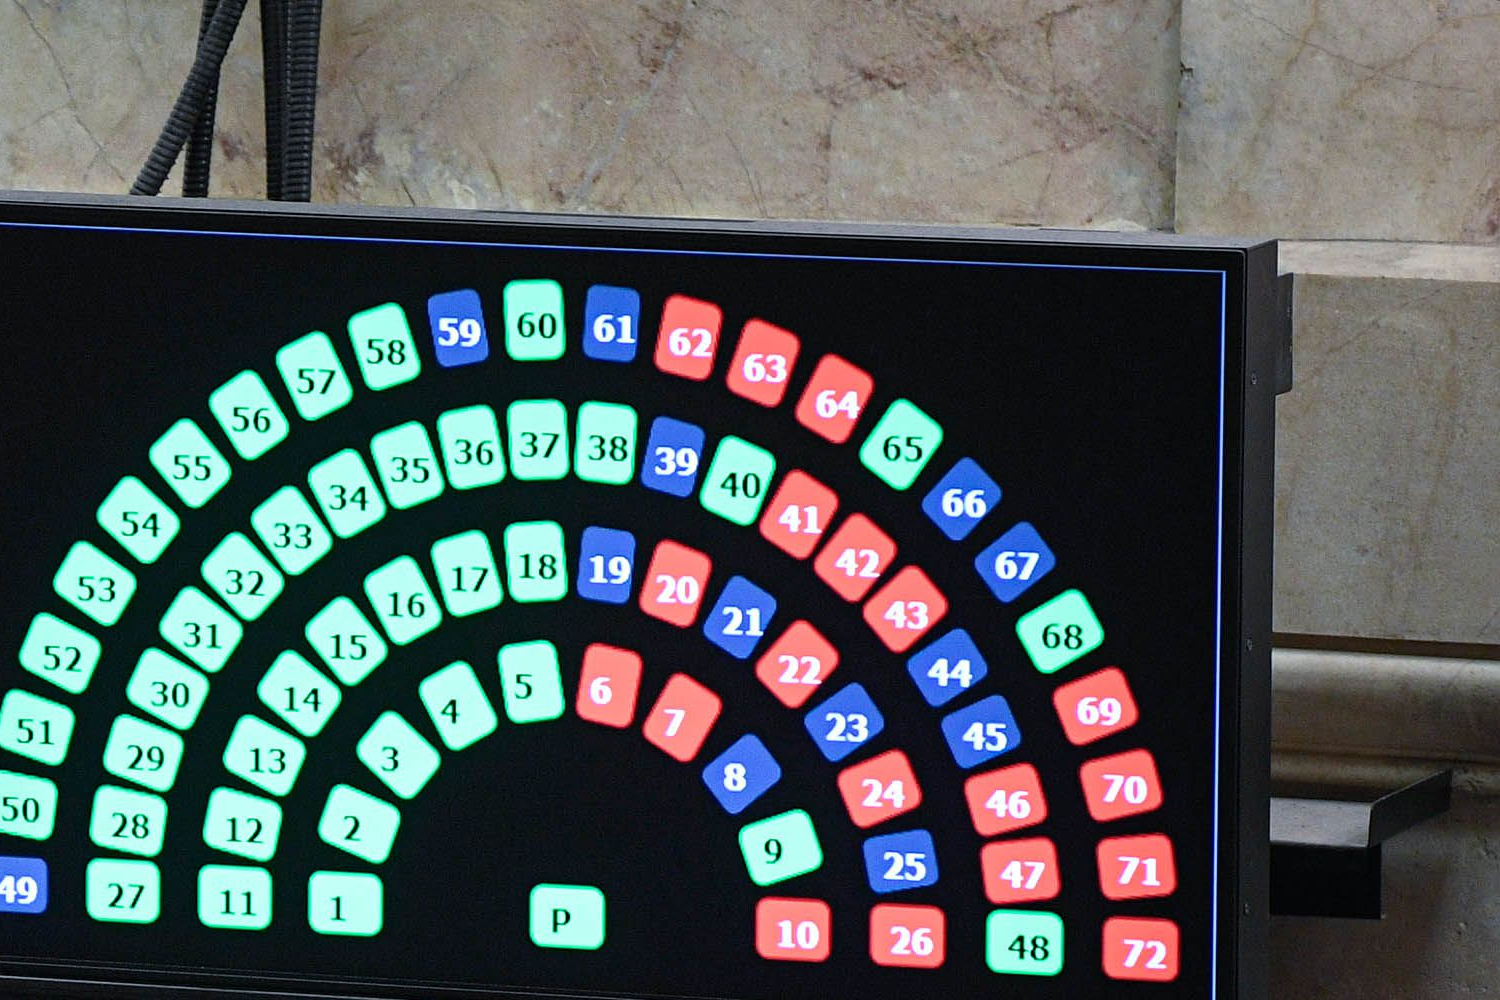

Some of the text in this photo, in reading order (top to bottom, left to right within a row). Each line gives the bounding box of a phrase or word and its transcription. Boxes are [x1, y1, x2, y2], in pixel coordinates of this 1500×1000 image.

[438, 318, 481, 347] 59
[516, 312, 557, 340] 60
[593, 314, 635, 344] 61
[366, 338, 406, 366] 58
[669, 327, 713, 357] 62
[297, 368, 336, 395] 57
[743, 353, 787, 383] 63
[815, 389, 861, 420] 64
[232, 406, 271, 433] 56
[454, 439, 494, 466] 36
[520, 431, 560, 459] 37
[588, 434, 628, 462] 38
[882, 435, 923, 463] 65
[173, 454, 211, 481] 55
[391, 456, 430, 484] 35
[655, 447, 698, 476] 39
[329, 484, 368, 512] 34
[719, 472, 761, 499] 40
[942, 488, 986, 518] 66
[121, 511, 160, 538] 54
[778, 504, 822, 534] 41
[273, 522, 312, 550] 33
[520, 553, 557, 580] 18
[590, 555, 631, 584] 19
[835, 548, 880, 578] 42
[995, 551, 1039, 580] 67
[78, 576, 116, 603] 53
[225, 569, 264, 597] 32
[452, 566, 489, 593] 17
[656, 574, 700, 605] 20
[390, 591, 426, 618] 16
[883, 600, 929, 630] 43
[722, 606, 764, 636] 21
[183, 622, 220, 649] 31
[331, 633, 367, 661] 15
[1041, 623, 1084, 650] 68
[43, 645, 82, 672] 52
[778, 654, 822, 685] 22
[515, 673, 533, 700] 5
[927, 658, 973, 688] 44
[151, 681, 190, 708] 30
[284, 686, 321, 713] 14
[589, 676, 613, 705] 6
[440, 698, 459, 725] 4
[663, 708, 686, 737] 7
[1077, 696, 1122, 726] 69
[17, 718, 54, 745] 51
[826, 712, 869, 742] 23
[963, 722, 1007, 751] 45
[127, 744, 165, 771] 29
[251, 747, 286, 774] 13
[381, 746, 399, 772] 3
[723, 763, 747, 792] 8
[1102, 774, 1148, 804] 70
[861, 778, 906, 809] 24
[985, 789, 1031, 819] 46
[2, 796, 40, 823] 50
[111, 812, 150, 839] 28
[226, 817, 263, 844] 12
[344, 815, 360, 841] 2
[764, 838, 783, 864] 9
[883, 851, 926, 881] 25
[1000, 860, 1046, 890] 47
[1117, 856, 1161, 887] 71
[108, 883, 145, 909] 27
[221, 889, 256, 916] 11
[331, 896, 345, 921] 1
[552, 908, 571, 934] P
[777, 919, 820, 950] 10
[890, 925, 934, 956] 26
[1007, 934, 1050, 961] 48
[1123, 939, 1167, 969] 72
